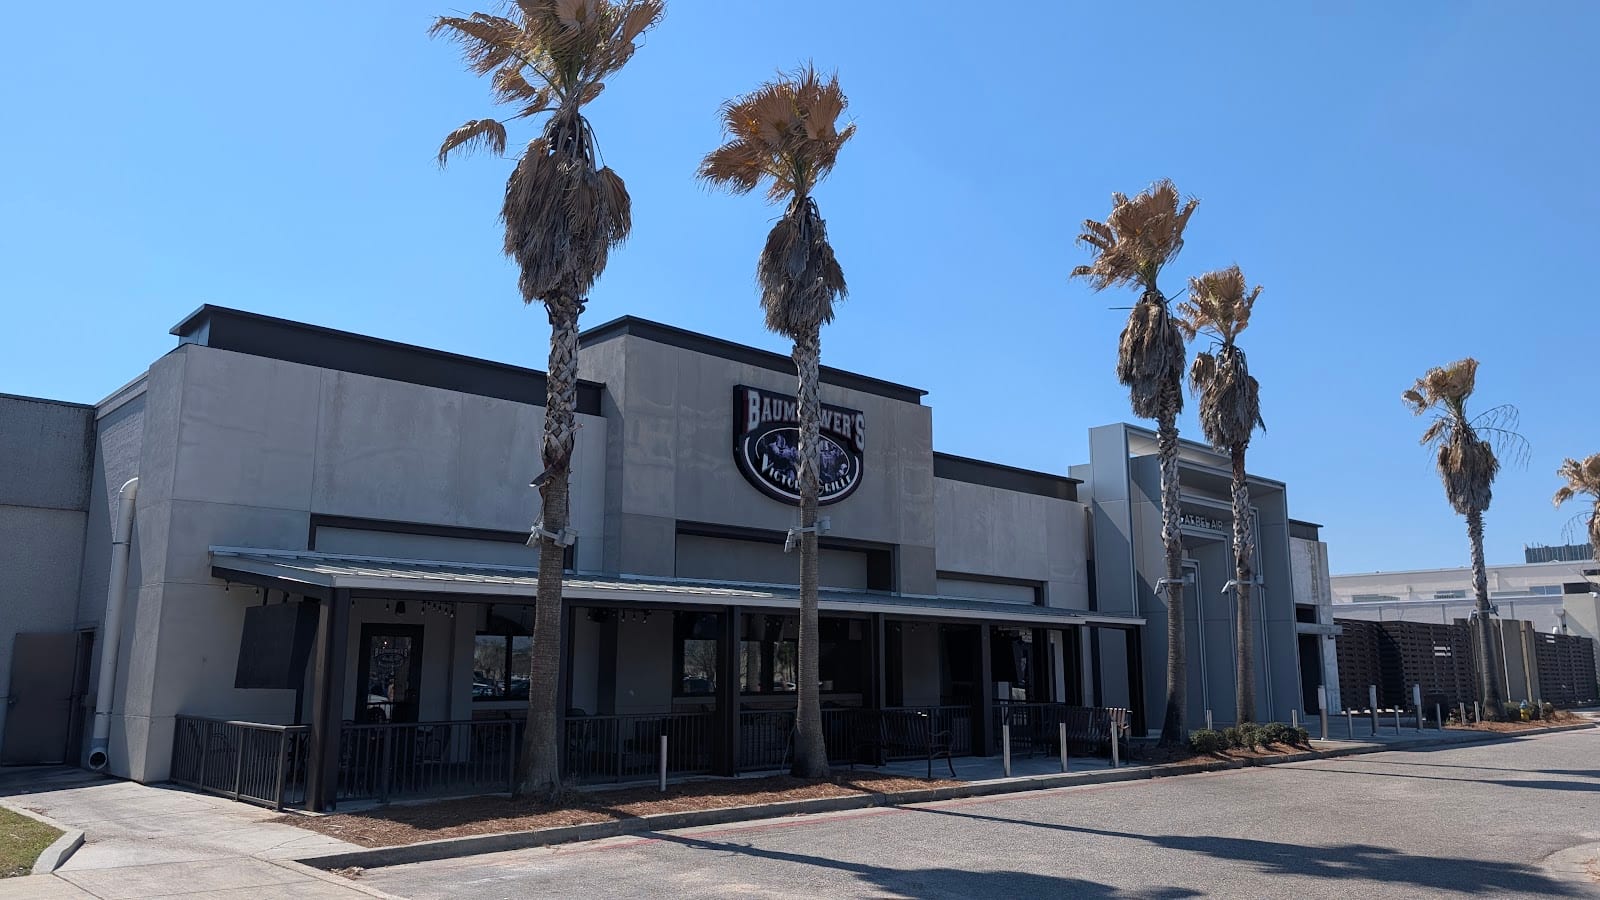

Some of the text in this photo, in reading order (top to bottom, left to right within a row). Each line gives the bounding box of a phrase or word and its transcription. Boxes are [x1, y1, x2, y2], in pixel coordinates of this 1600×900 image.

[748, 389, 865, 452] BAUMWER'S
[1184, 514, 1195, 525] AT
[1211, 519, 1223, 531] AIR
